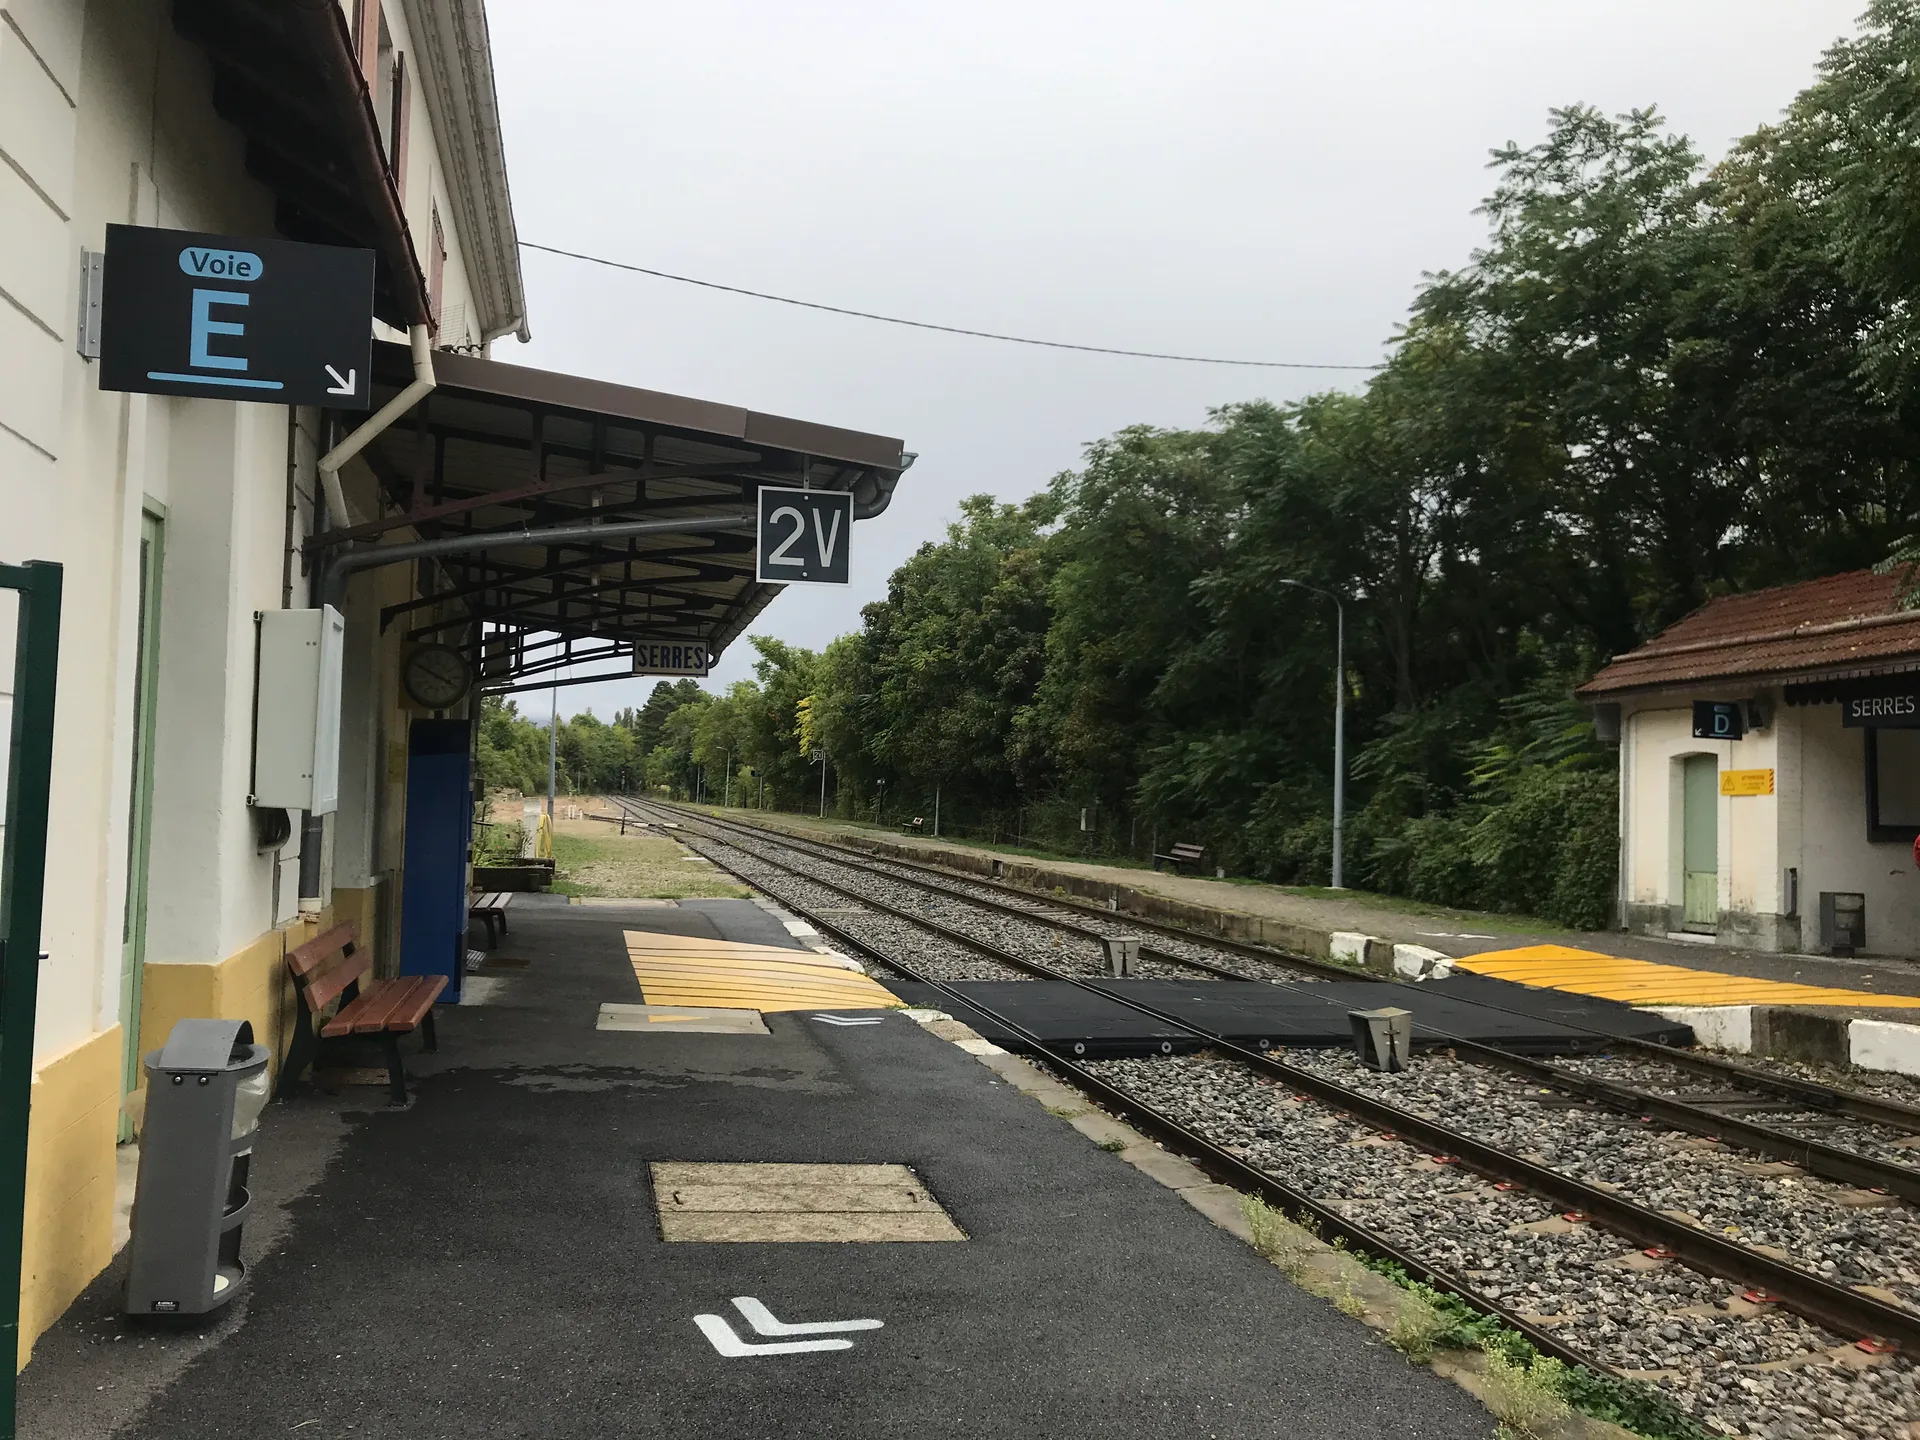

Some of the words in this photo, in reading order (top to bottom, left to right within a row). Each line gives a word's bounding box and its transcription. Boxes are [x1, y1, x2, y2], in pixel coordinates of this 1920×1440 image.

[189, 250, 251, 277] Voie
[190, 288, 250, 371] E
[768, 506, 842, 568] 2V
[637, 644, 704, 669] SERRES
[1852, 695, 1915, 717] SERRES
[1714, 714, 1729, 734] D
